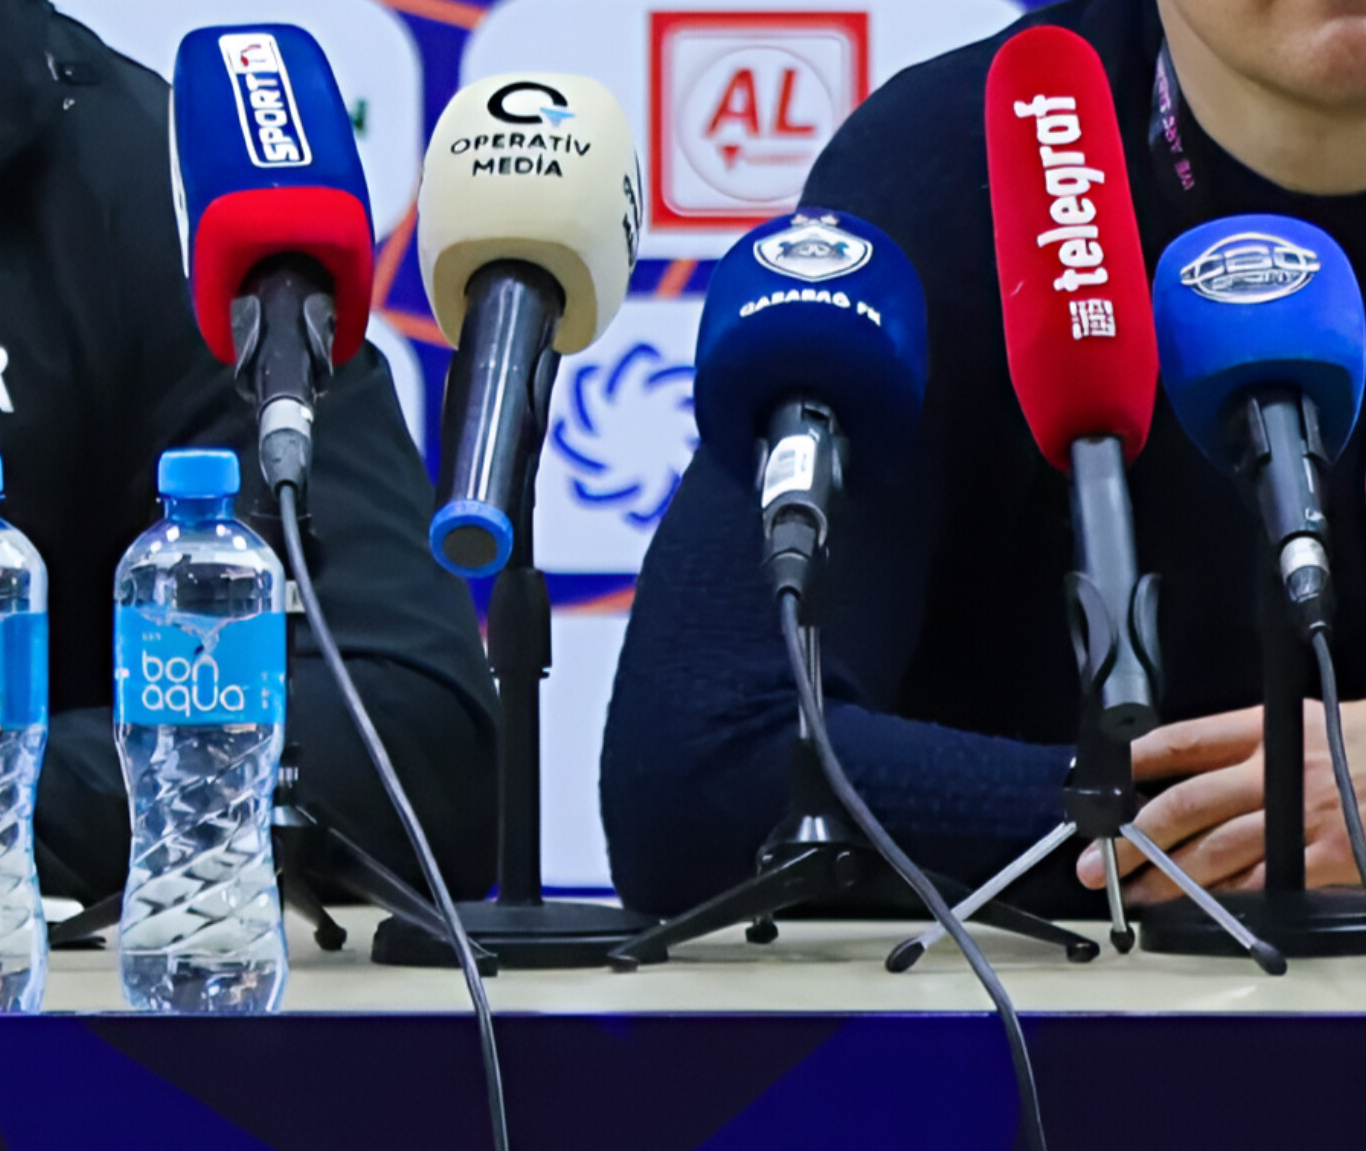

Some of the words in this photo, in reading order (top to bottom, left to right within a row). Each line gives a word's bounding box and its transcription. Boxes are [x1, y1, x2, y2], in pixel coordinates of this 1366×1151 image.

[702, 66, 818, 140] AL
[1013, 94, 1108, 292] telegraf
[142, 650, 219, 683] bon
[141, 684, 245, 718] aqua
